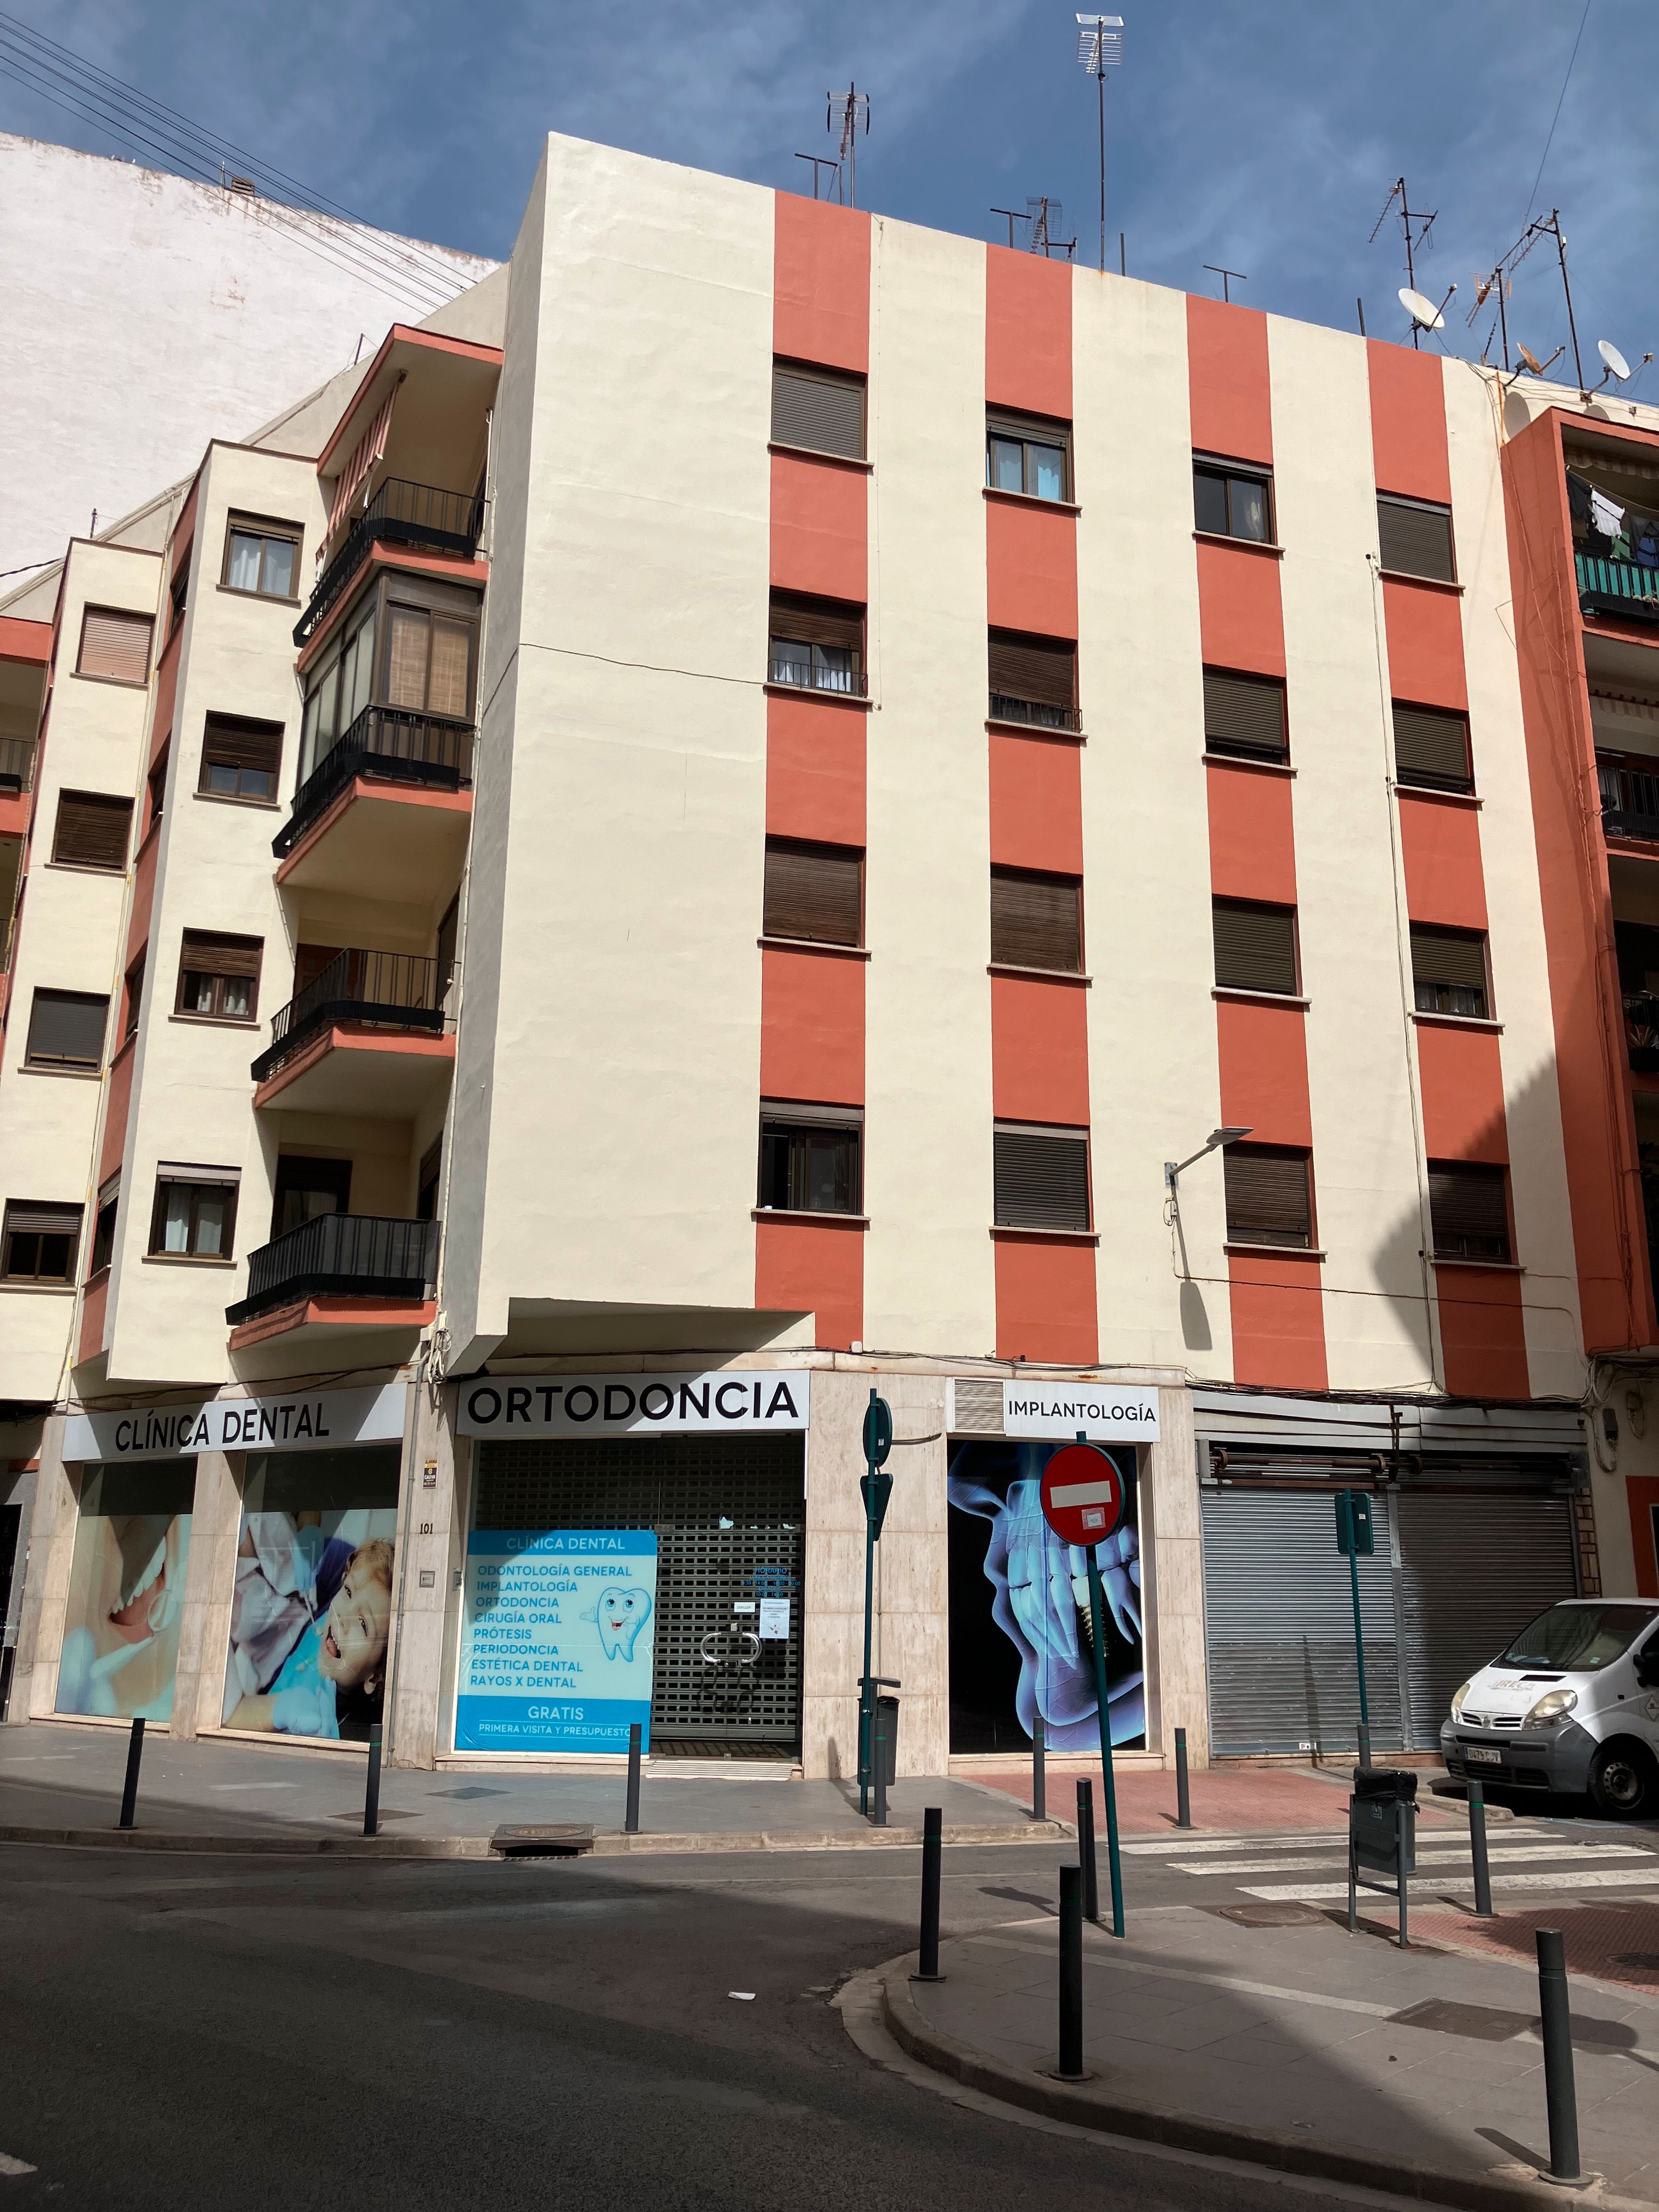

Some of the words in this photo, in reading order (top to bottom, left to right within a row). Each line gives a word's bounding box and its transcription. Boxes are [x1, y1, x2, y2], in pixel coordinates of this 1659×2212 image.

[467, 1381, 799, 1424] ORTODONCIA
[1009, 1401, 1156, 1422] IMPLANTOLOGÍA
[115, 1409, 210, 1452] CLÍNICA
[222, 1403, 329, 1444] DENTAL
[420, 1523, 433, 1534] 101
[506, 1536, 564, 1549] CLÍNICA
[568, 1538, 625, 1549] DENTAL
[478, 1564, 570, 1576] ODONTOLOGÍA
[573, 1566, 632, 1576] GENERAL
[477, 1579, 578, 1592] IMPLANTOLOGÍA
[476, 1597, 560, 1607] ORTODONCIA
[475, 1611, 525, 1623] CIRUGÍA
[529, 1613, 562, 1623] ORAL
[473, 1627, 532, 1639] PRÓTESIS
[473, 1645, 558, 1655] PERIODONCIA
[472, 1658, 529, 1670] ESTÉTICA
[534, 1661, 583, 1672] DENTAL
[471, 1675, 512, 1686] RAYOS
[515, 1676, 523, 1686] X
[527, 1677, 577, 1688] DENTAL
[528, 1706, 584, 1720] GRATIS
[479, 1724, 520, 1733] PRIMERA
[522, 1725, 552, 1734] VISITA
[564, 1726, 630, 1736] PRESUPUESTO
[1469, 1749, 1484, 1760] 0479
